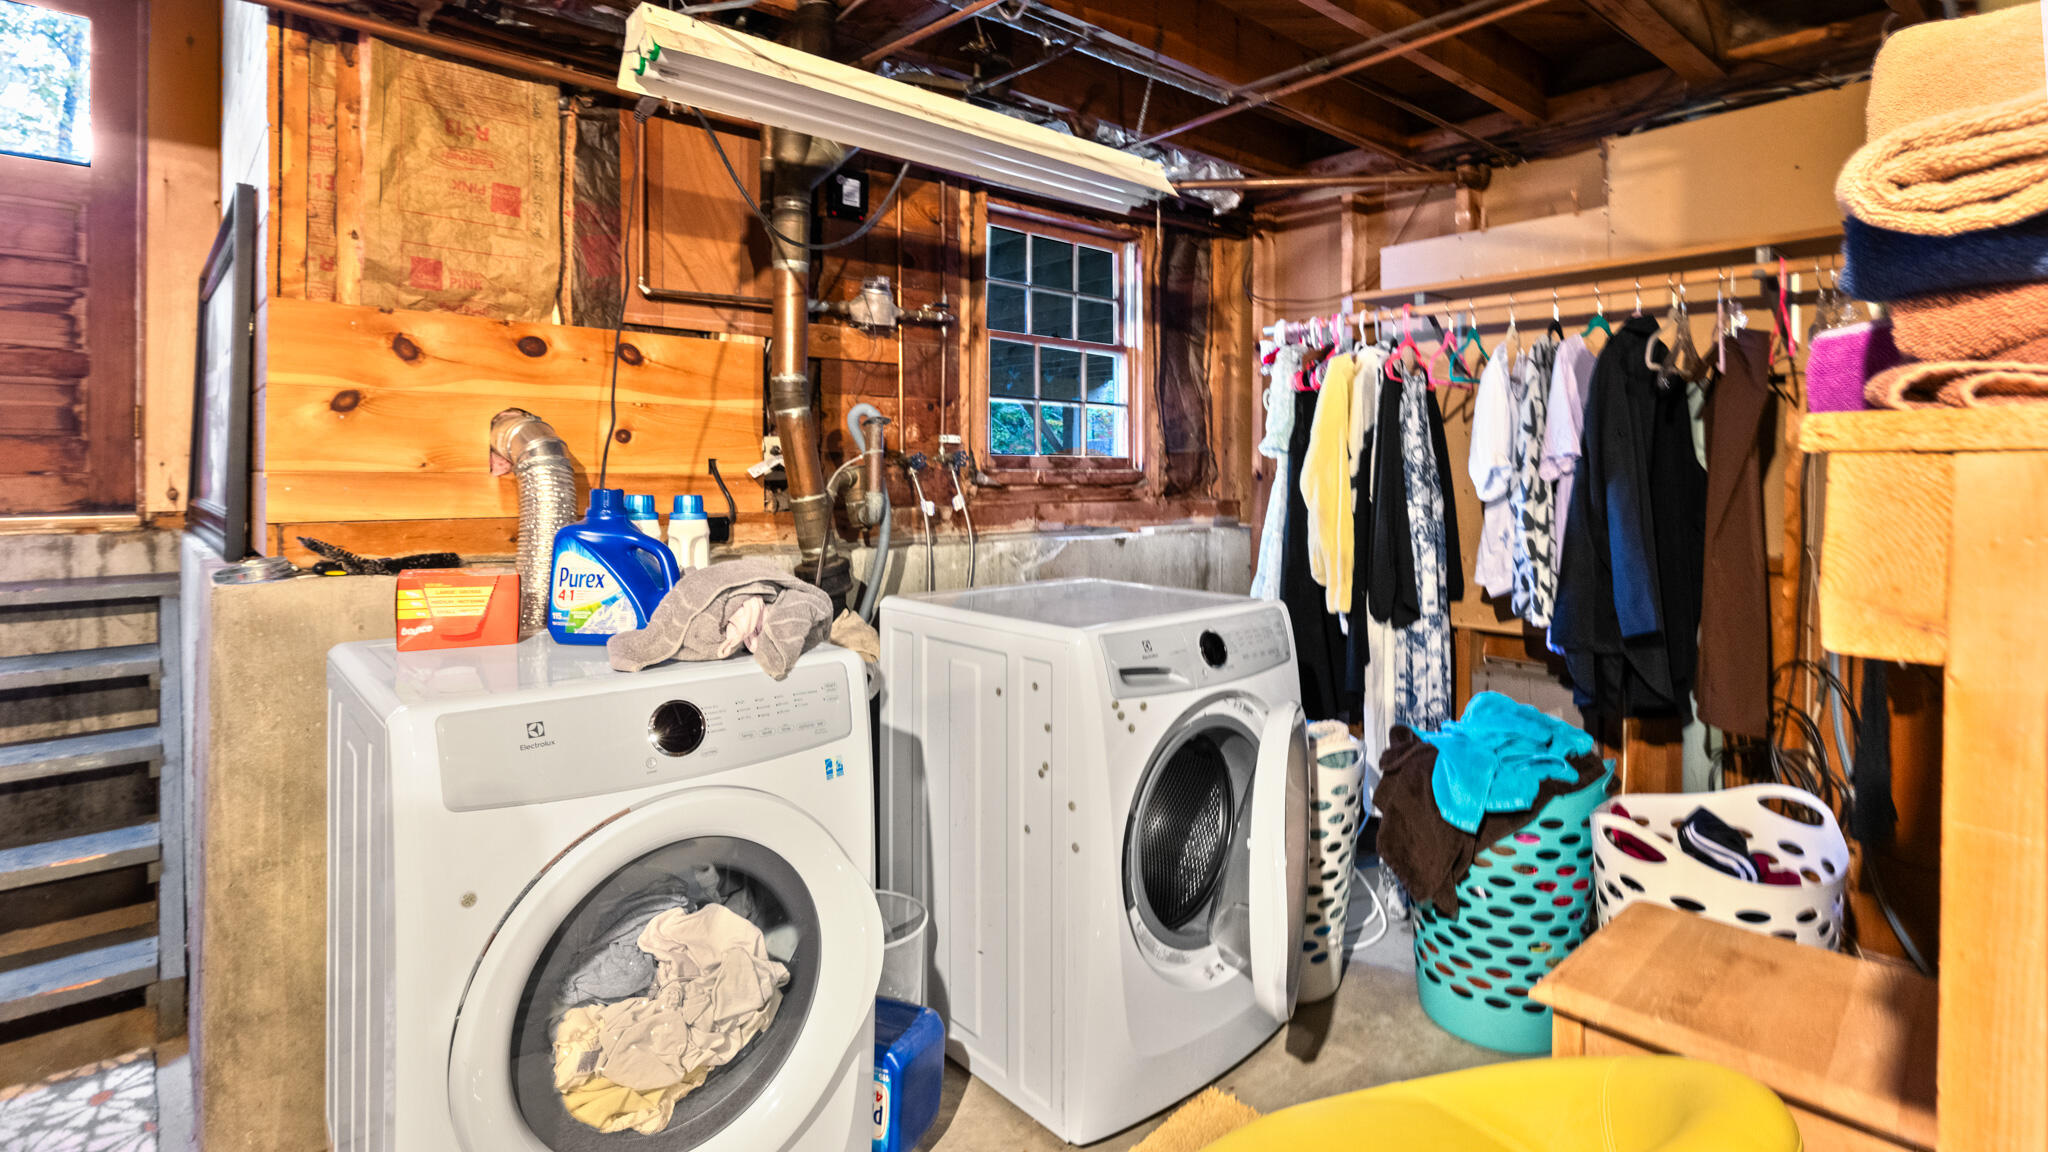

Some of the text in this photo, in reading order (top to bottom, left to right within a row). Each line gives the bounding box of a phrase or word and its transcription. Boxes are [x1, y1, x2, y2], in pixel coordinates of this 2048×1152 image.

[444, 119, 490, 142] R-13
[559, 567, 605, 588] Purex
[520, 740, 556, 751] Electrolux
